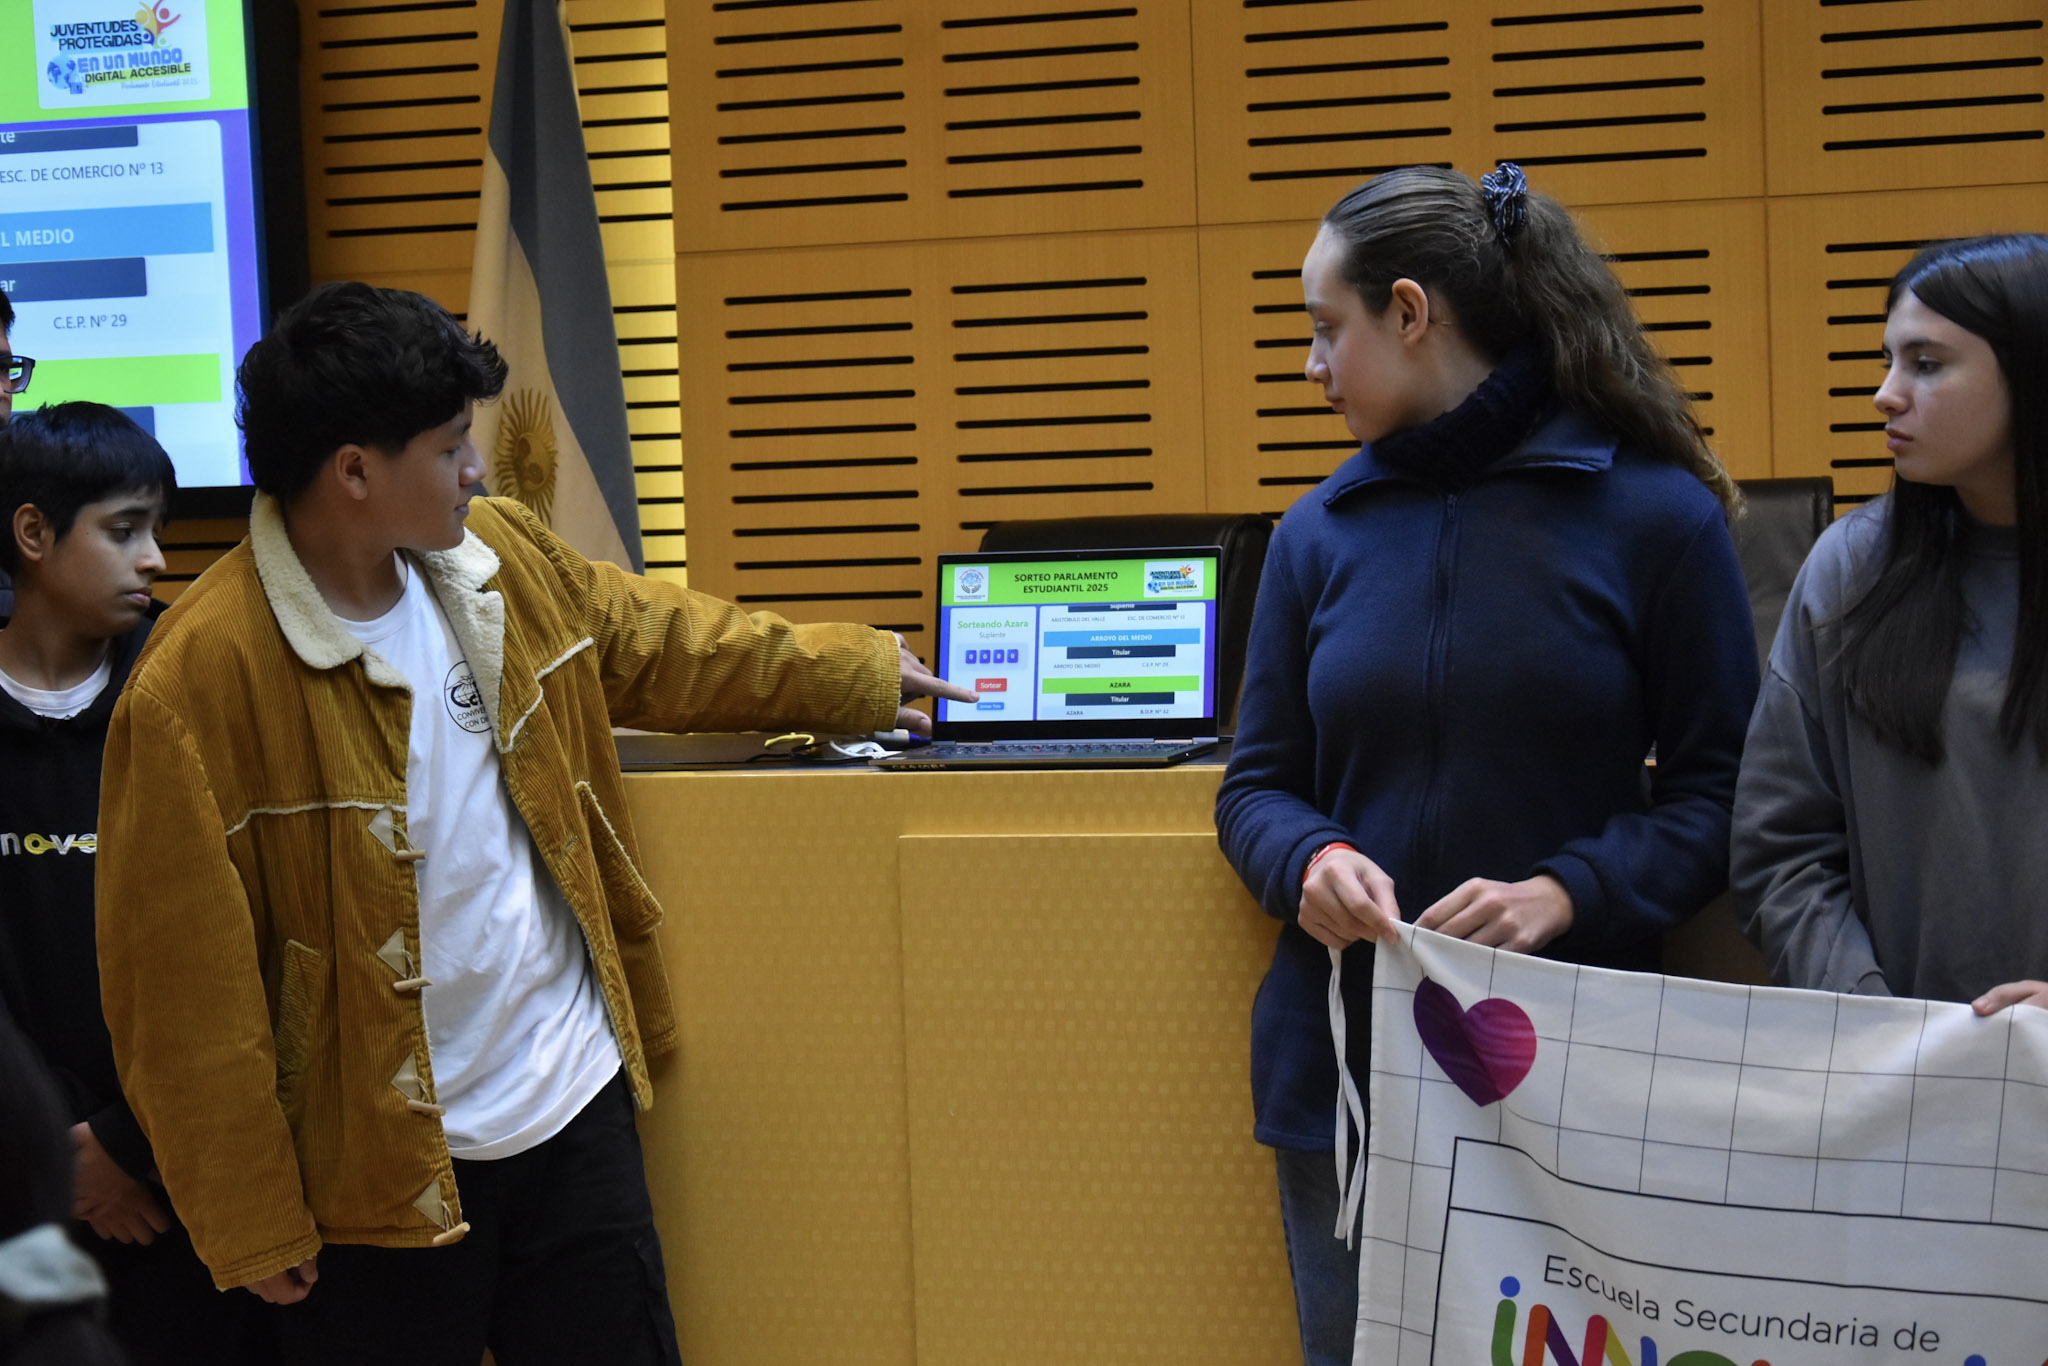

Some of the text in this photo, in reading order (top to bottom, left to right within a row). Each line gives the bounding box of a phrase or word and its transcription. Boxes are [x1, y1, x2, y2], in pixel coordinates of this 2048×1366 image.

[50, 19, 138, 37] JUVENTUDES
[58, 34, 142, 51] PROTEGIDAS
[77, 48, 183, 73] EN UN MUNDO
[84, 63, 191, 83] DIGITAL ACCESIBLE
[0, 170, 27, 183] ESC.
[31, 169, 48, 182] DE
[52, 163, 125, 181] COMERCIO
[151, 162, 164, 175] 13
[16, 228, 75, 246] MEDIO
[53, 315, 86, 330] C.E.P.
[111, 314, 127, 327] 29
[1014, 572, 1118, 582] SORTEO PARLAMENTO
[1023, 583, 1109, 593] ESTUDIANTIL 2025
[957, 620, 1029, 629] Sorteando Azara
[1111, 648, 1131, 656] Titular
[1110, 695, 1130, 703] Titular
[464, 719, 480, 728] CON
[1543, 1254, 1660, 1321] Escuela
[1673, 1299, 1879, 1348] Secundaria
[1893, 1321, 1940, 1352] de
